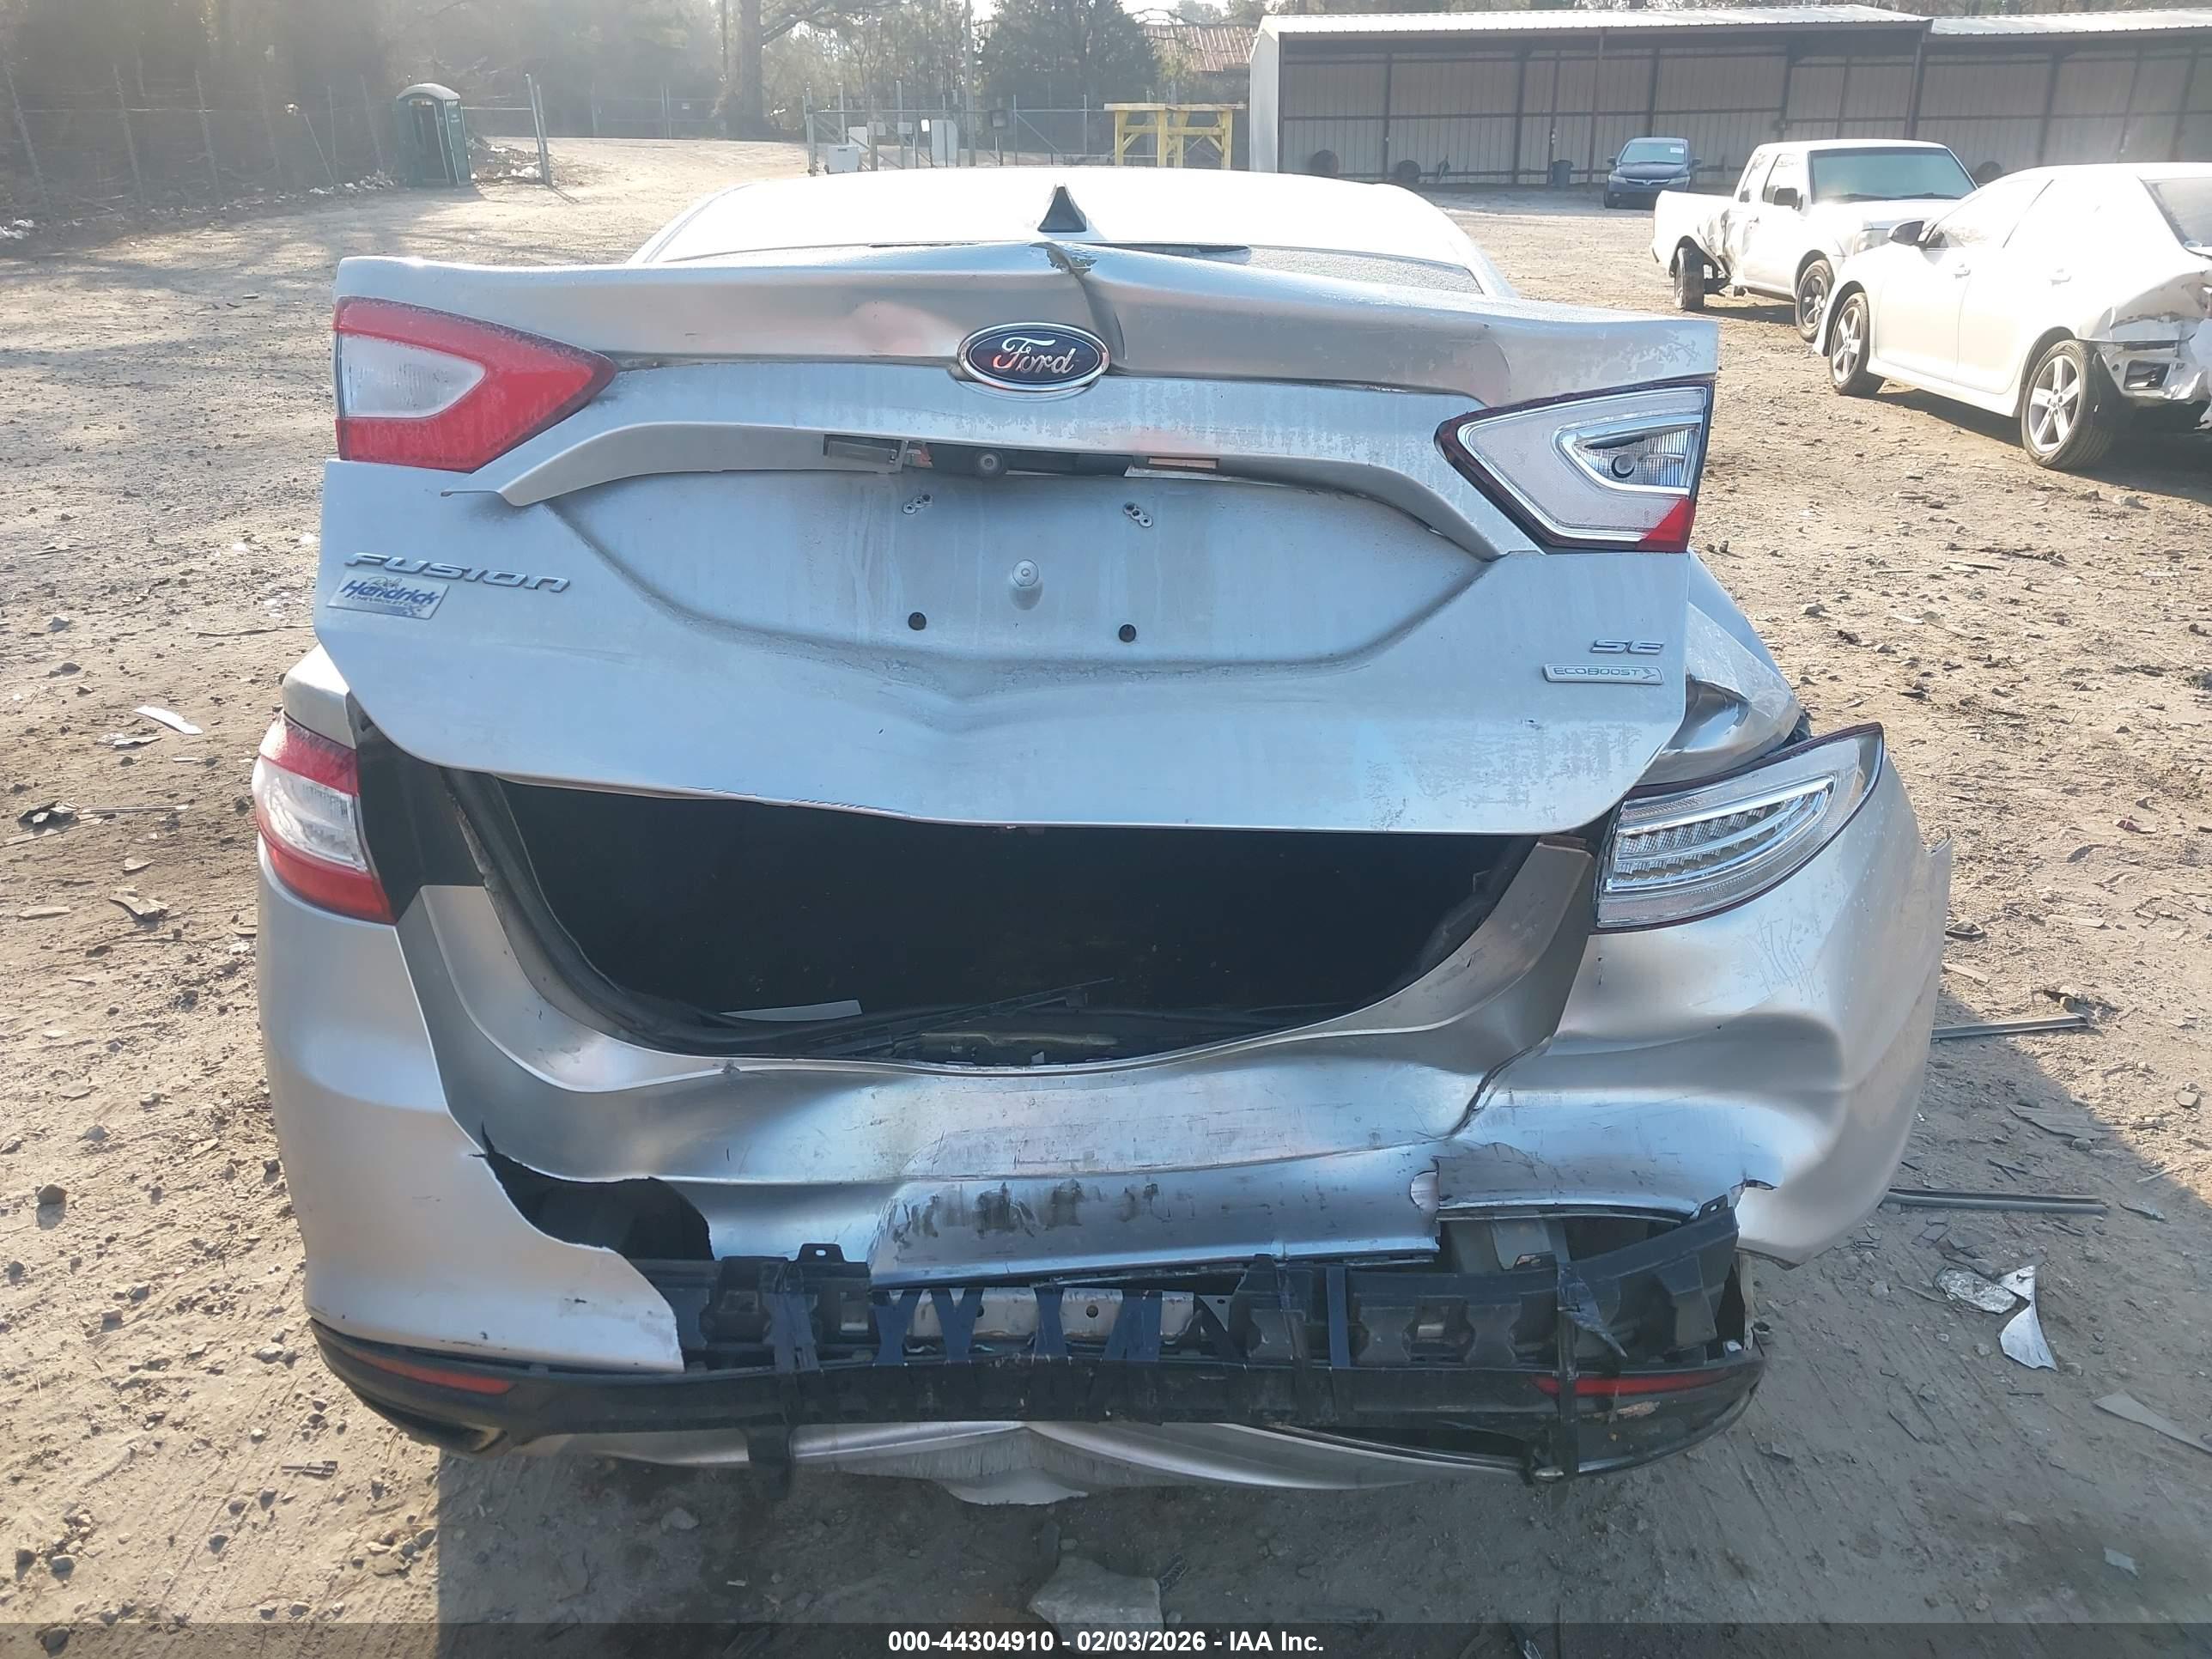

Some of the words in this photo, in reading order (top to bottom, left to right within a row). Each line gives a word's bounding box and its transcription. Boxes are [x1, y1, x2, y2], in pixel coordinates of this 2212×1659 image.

[993, 337, 1077, 374] Ford
[343, 552, 571, 592] FUSION
[339, 580, 441, 605] Hendrick
[1589, 639, 1664, 655] SE
[1553, 666, 1641, 676] ECOBOOST
